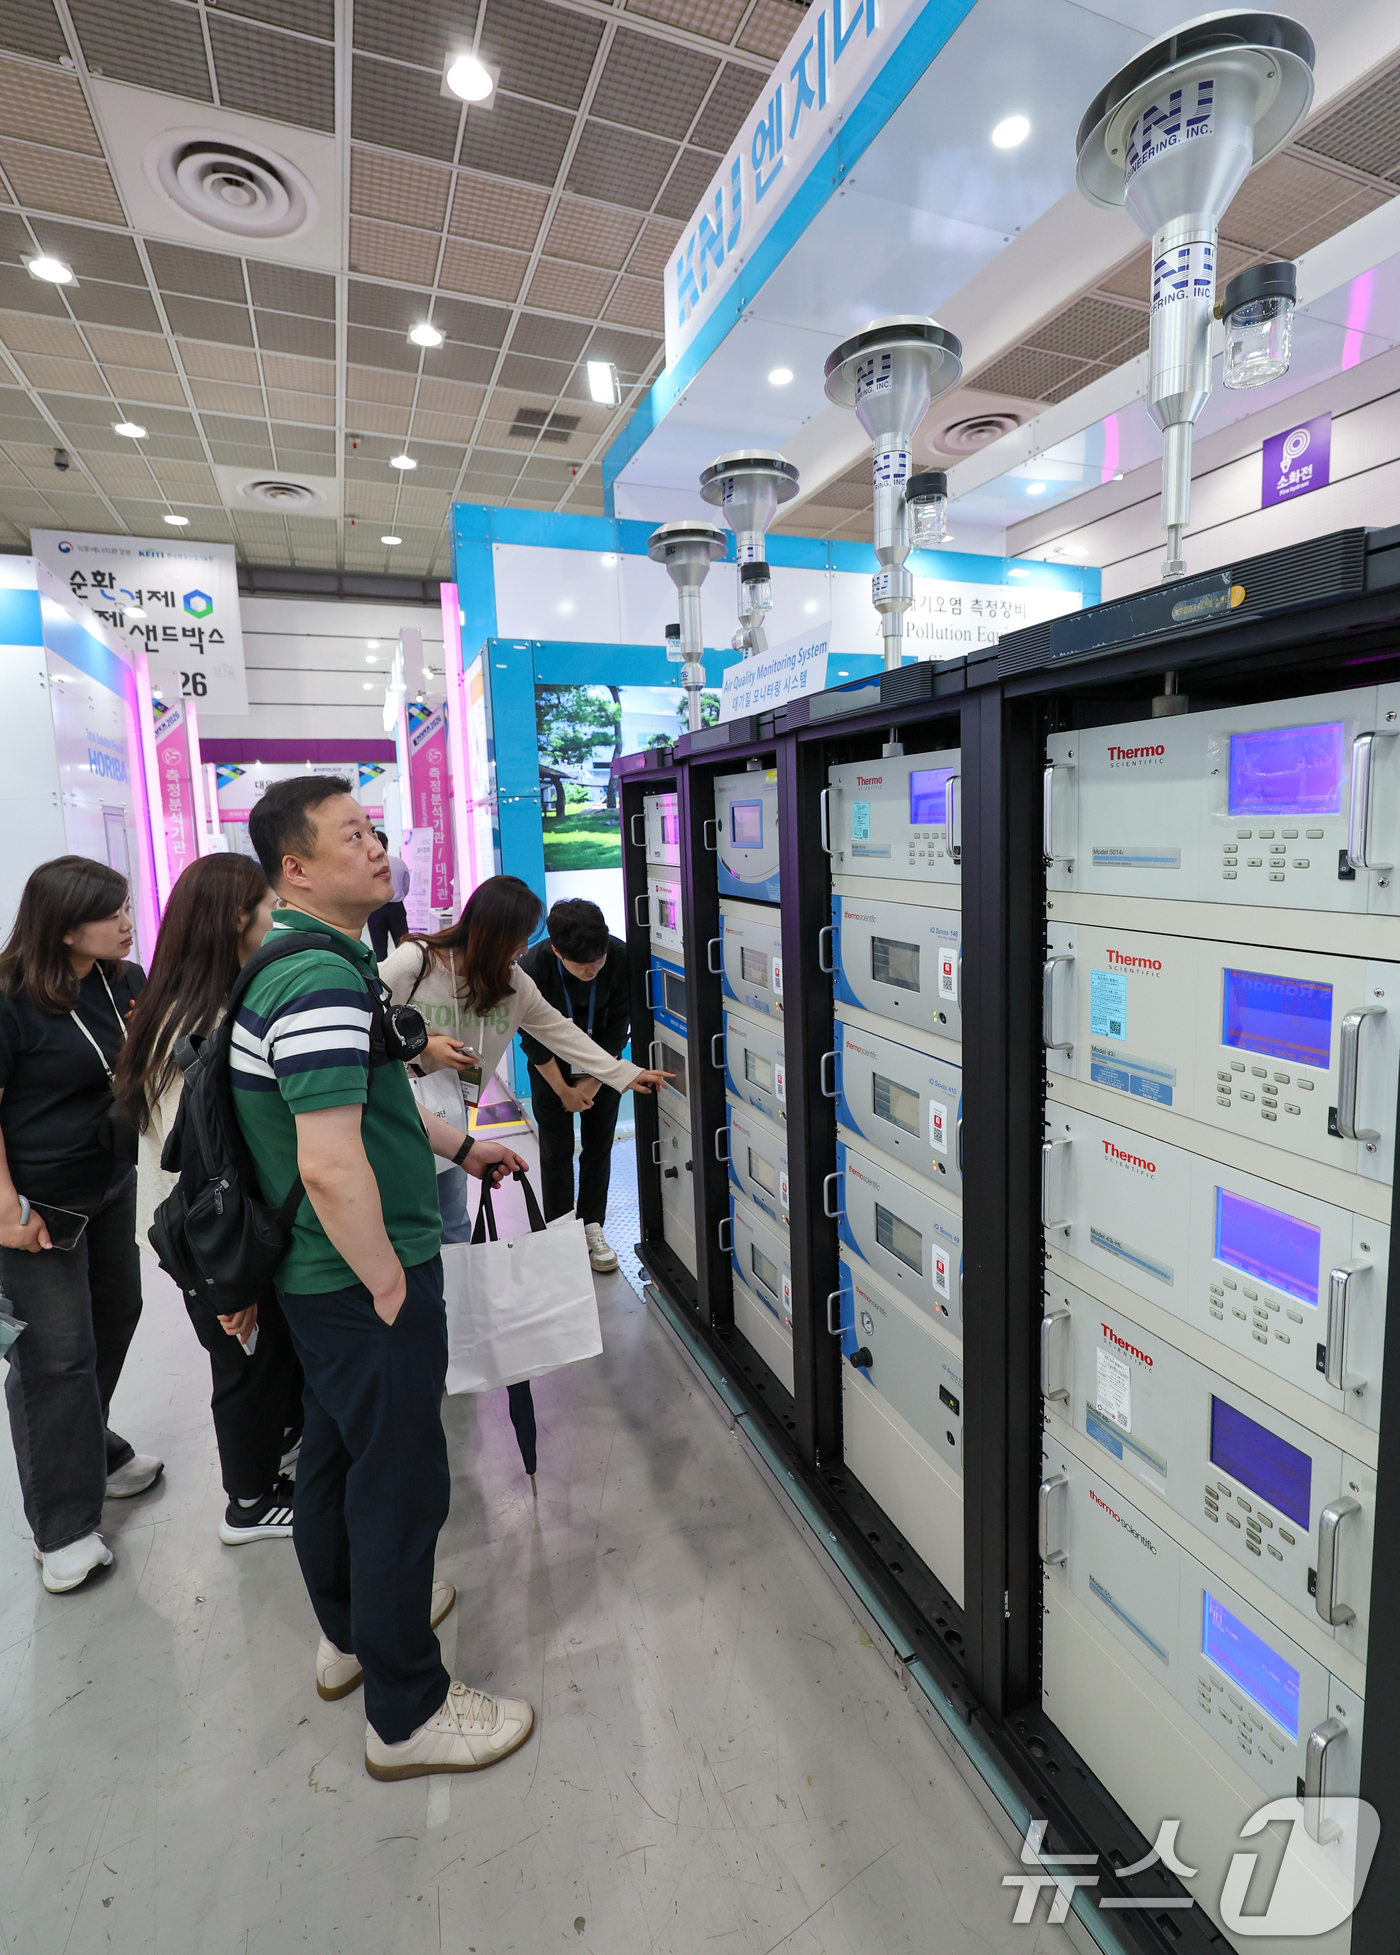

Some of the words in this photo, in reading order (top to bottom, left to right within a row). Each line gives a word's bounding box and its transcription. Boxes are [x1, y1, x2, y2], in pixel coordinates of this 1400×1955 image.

[1186, 124, 1213, 139] INC.
[676, 153, 742, 328] KNJ
[1153, 247, 1213, 302] NJ
[857, 353, 891, 393] NJ
[1276, 463, 1313, 490] 소화전
[138, 550, 164, 559] KEITI
[69, 569, 116, 599] 순환
[970, 597, 1026, 619] 측정장비
[94, 609, 125, 628] 제
[129, 624, 225, 655] 샌드박스
[906, 621, 972, 642] Pollution
[723, 678, 733, 694] Air
[733, 668, 756, 691] Quality
[756, 653, 797, 680] Monitoring
[797, 641, 828, 666] System
[732, 691, 752, 712] 대기질
[752, 679, 781, 704] 모니터링
[783, 669, 808, 694] 시스템
[166, 711, 181, 728] 2026
[1107, 744, 1165, 761] Thermo
[1110, 757, 1164, 769] SCIENTIFIC
[88, 747, 128, 784] HORIBA
[857, 776, 883, 786] Thermo
[165, 768, 187, 855] 측정분석기관
[428, 766, 445, 844] 측정분석기관
[1093, 848, 1109, 856] Model
[1109, 848, 1124, 856] 5014i
[435, 862, 449, 901] 대기관
[844, 911, 878, 924] thermoscientific
[929, 926, 936, 934] iQ
[949, 929, 959, 938] 146
[1106, 949, 1162, 971] Thermo
[1108, 964, 1161, 979] SCIENTIFIC
[846, 1040, 878, 1060] thermoscientific
[1091, 1045, 1107, 1056] Model
[1107, 1050, 1116, 1058] 43i
[928, 1077, 935, 1085] iQ
[948, 1085, 957, 1095] 410
[1102, 1140, 1156, 1173] Thermo
[1104, 1155, 1155, 1181] SCIENTIFIC
[848, 1164, 881, 1192] thermoscientific
[933, 1221, 940, 1231] iQ
[1090, 1227, 1106, 1240] Model
[1101, 1322, 1154, 1367] Thermo
[1103, 1337, 1153, 1374] SCIENTIFIC
[1089, 1489, 1157, 1555] thermoscientific
